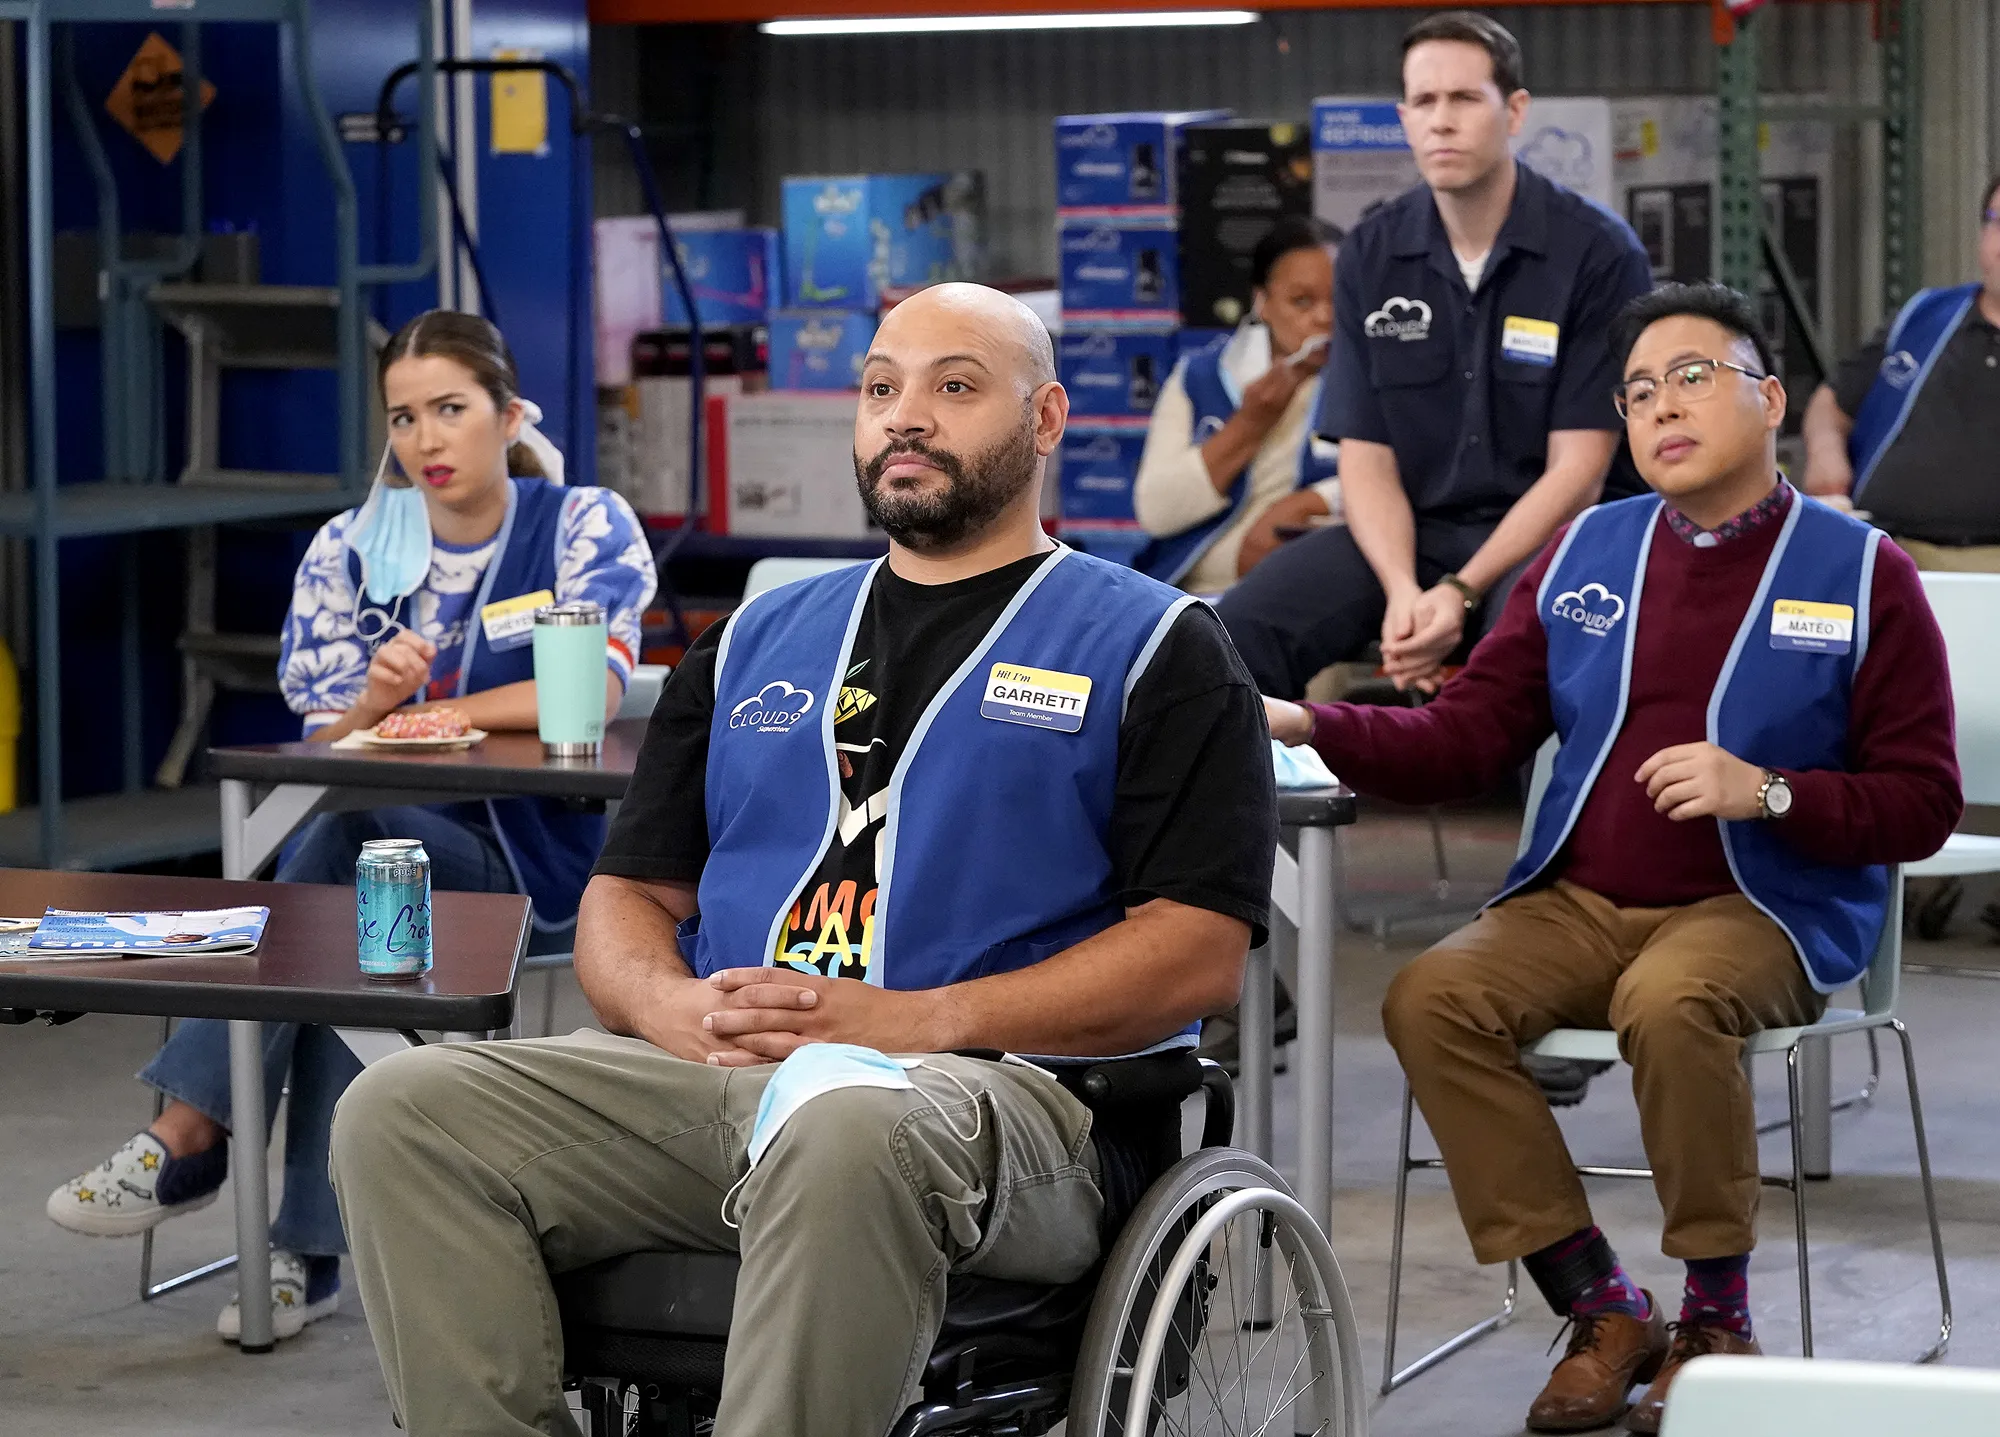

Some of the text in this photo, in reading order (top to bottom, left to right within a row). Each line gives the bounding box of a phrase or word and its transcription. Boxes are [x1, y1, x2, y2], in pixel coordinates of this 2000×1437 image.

[1551, 601, 1616, 631] CLOUD9
[1788, 620, 1835, 635] MATEO
[996, 669, 1031, 683] Hi! I'm
[993, 686, 1081, 711] GARRETT
[729, 710, 802, 730] CLOUD9
[1009, 709, 1053, 722] Team Member
[394, 868, 417, 877] PURE
